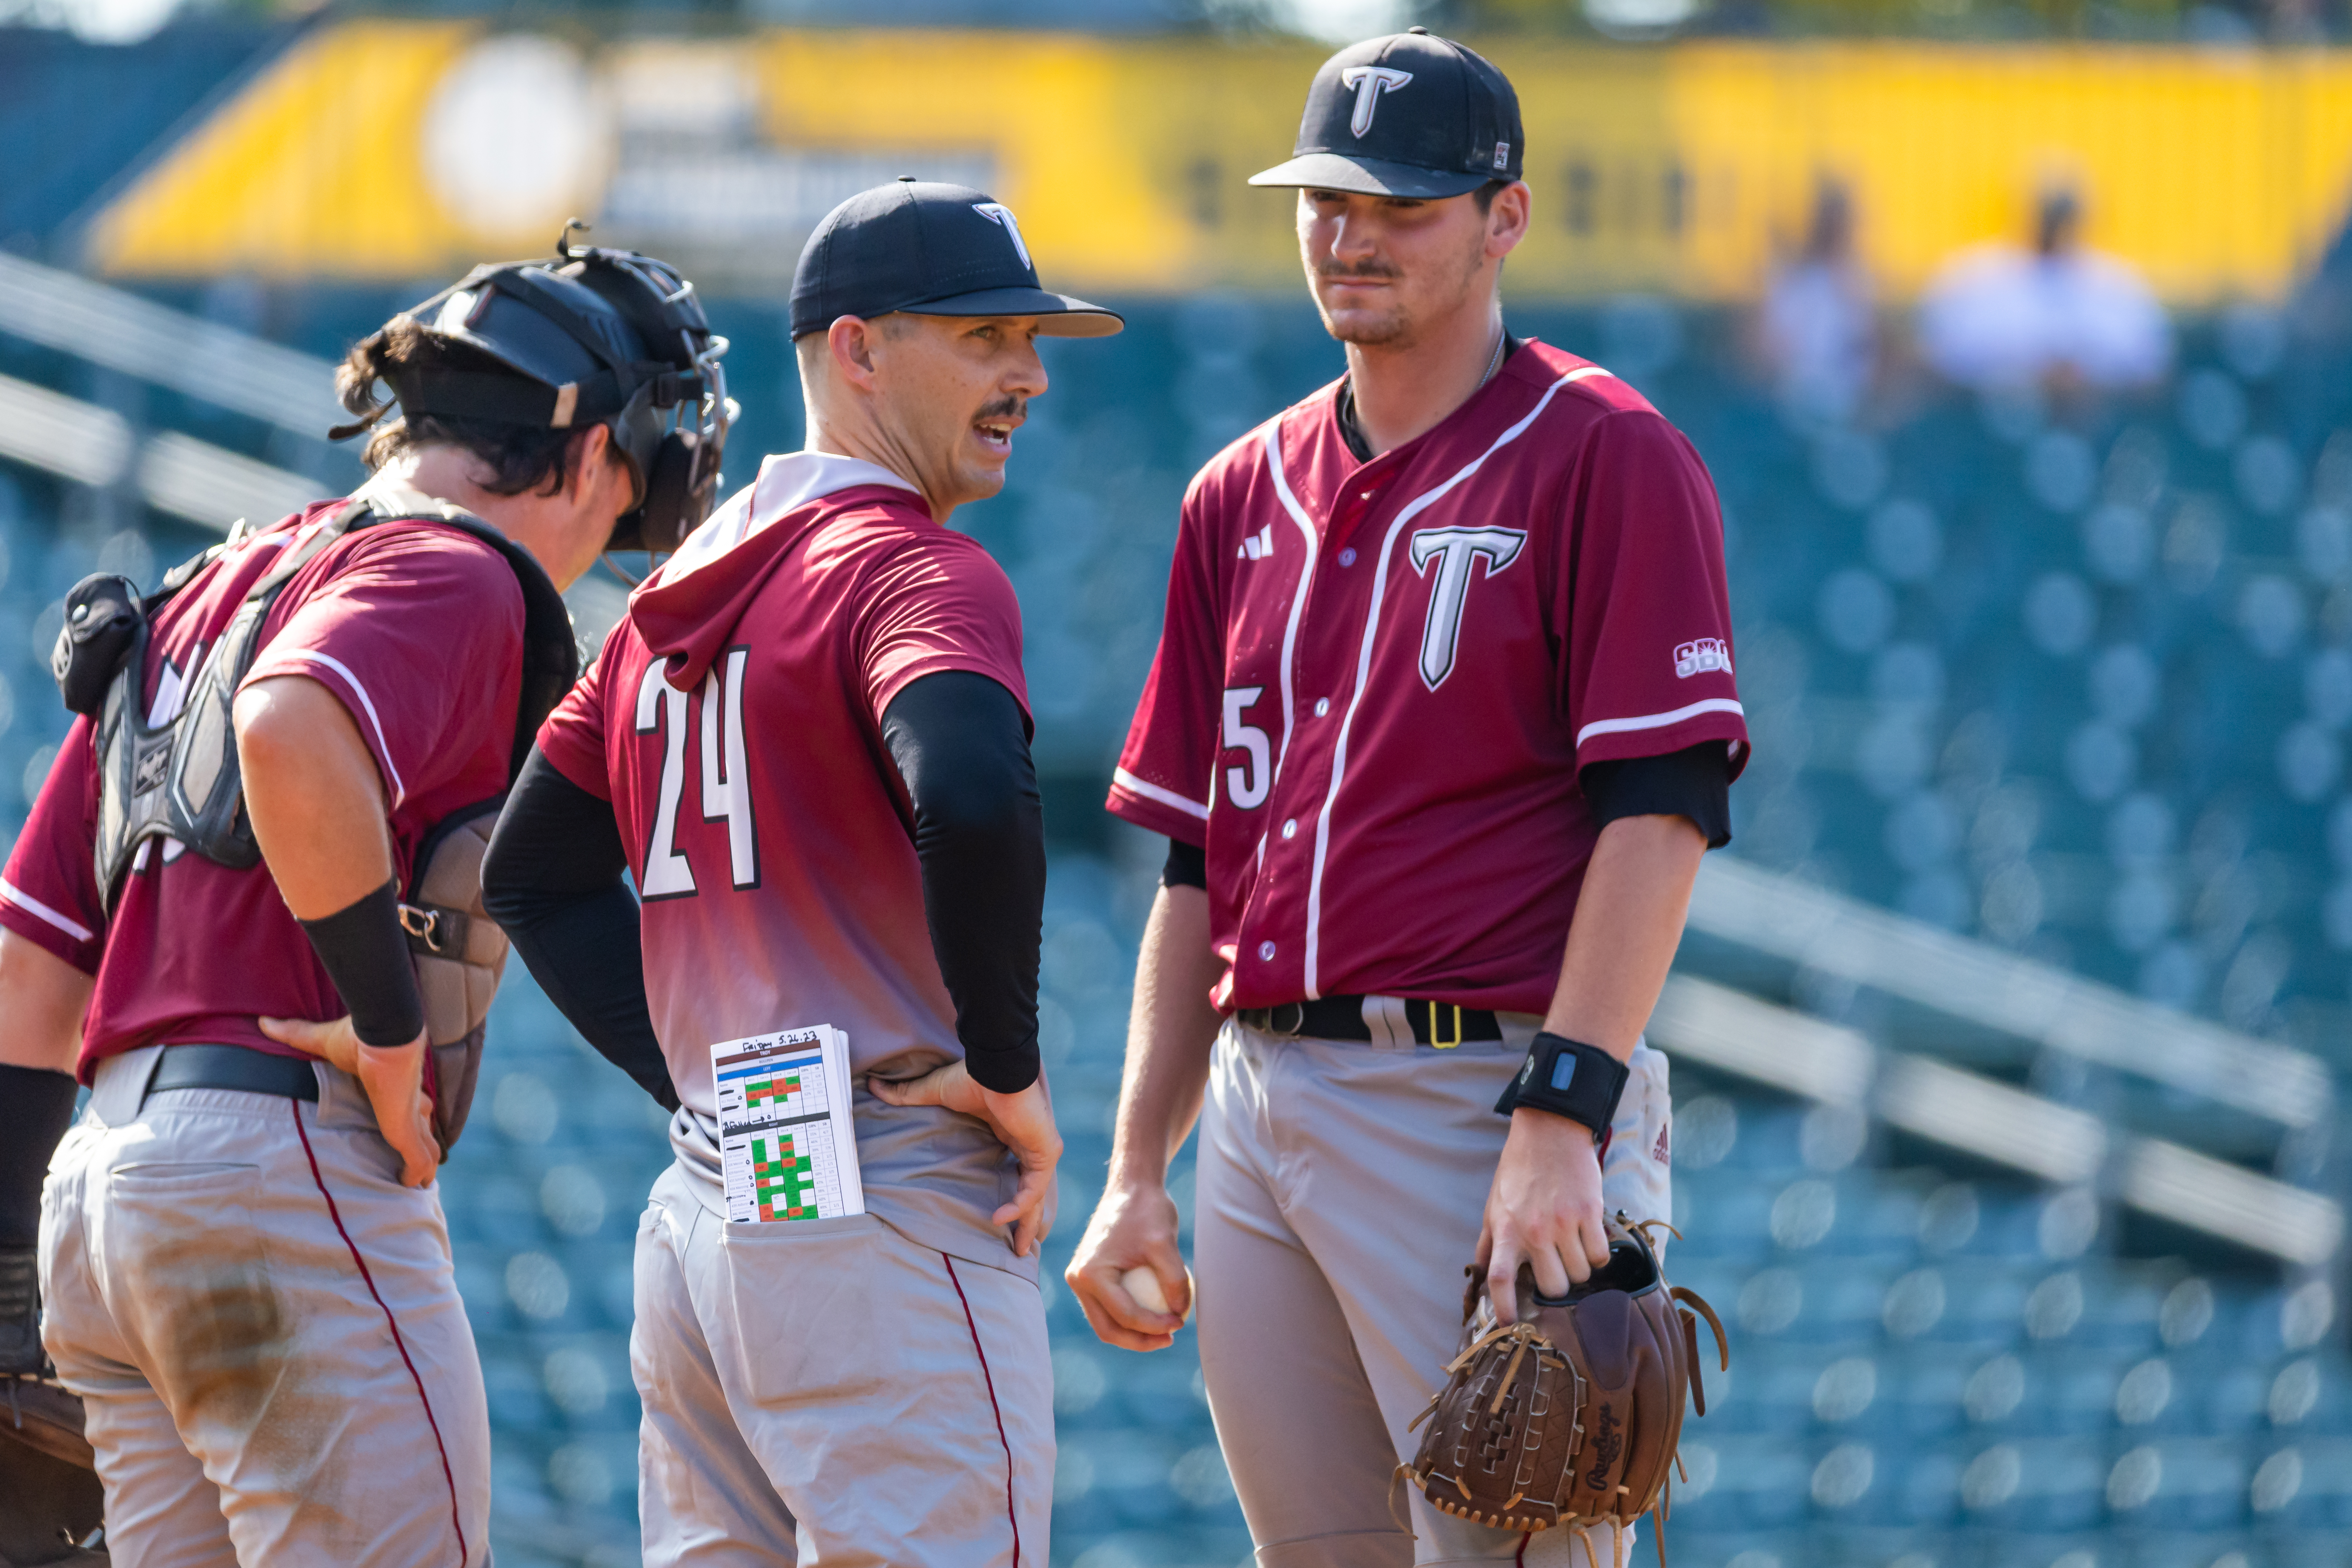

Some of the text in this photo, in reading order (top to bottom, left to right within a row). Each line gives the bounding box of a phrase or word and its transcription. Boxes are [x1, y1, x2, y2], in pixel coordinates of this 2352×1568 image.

[1342, 66, 1414, 139] T
[1409, 525, 1527, 693] T
[636, 644, 761, 903] 24
[1222, 684, 1271, 811] 5
